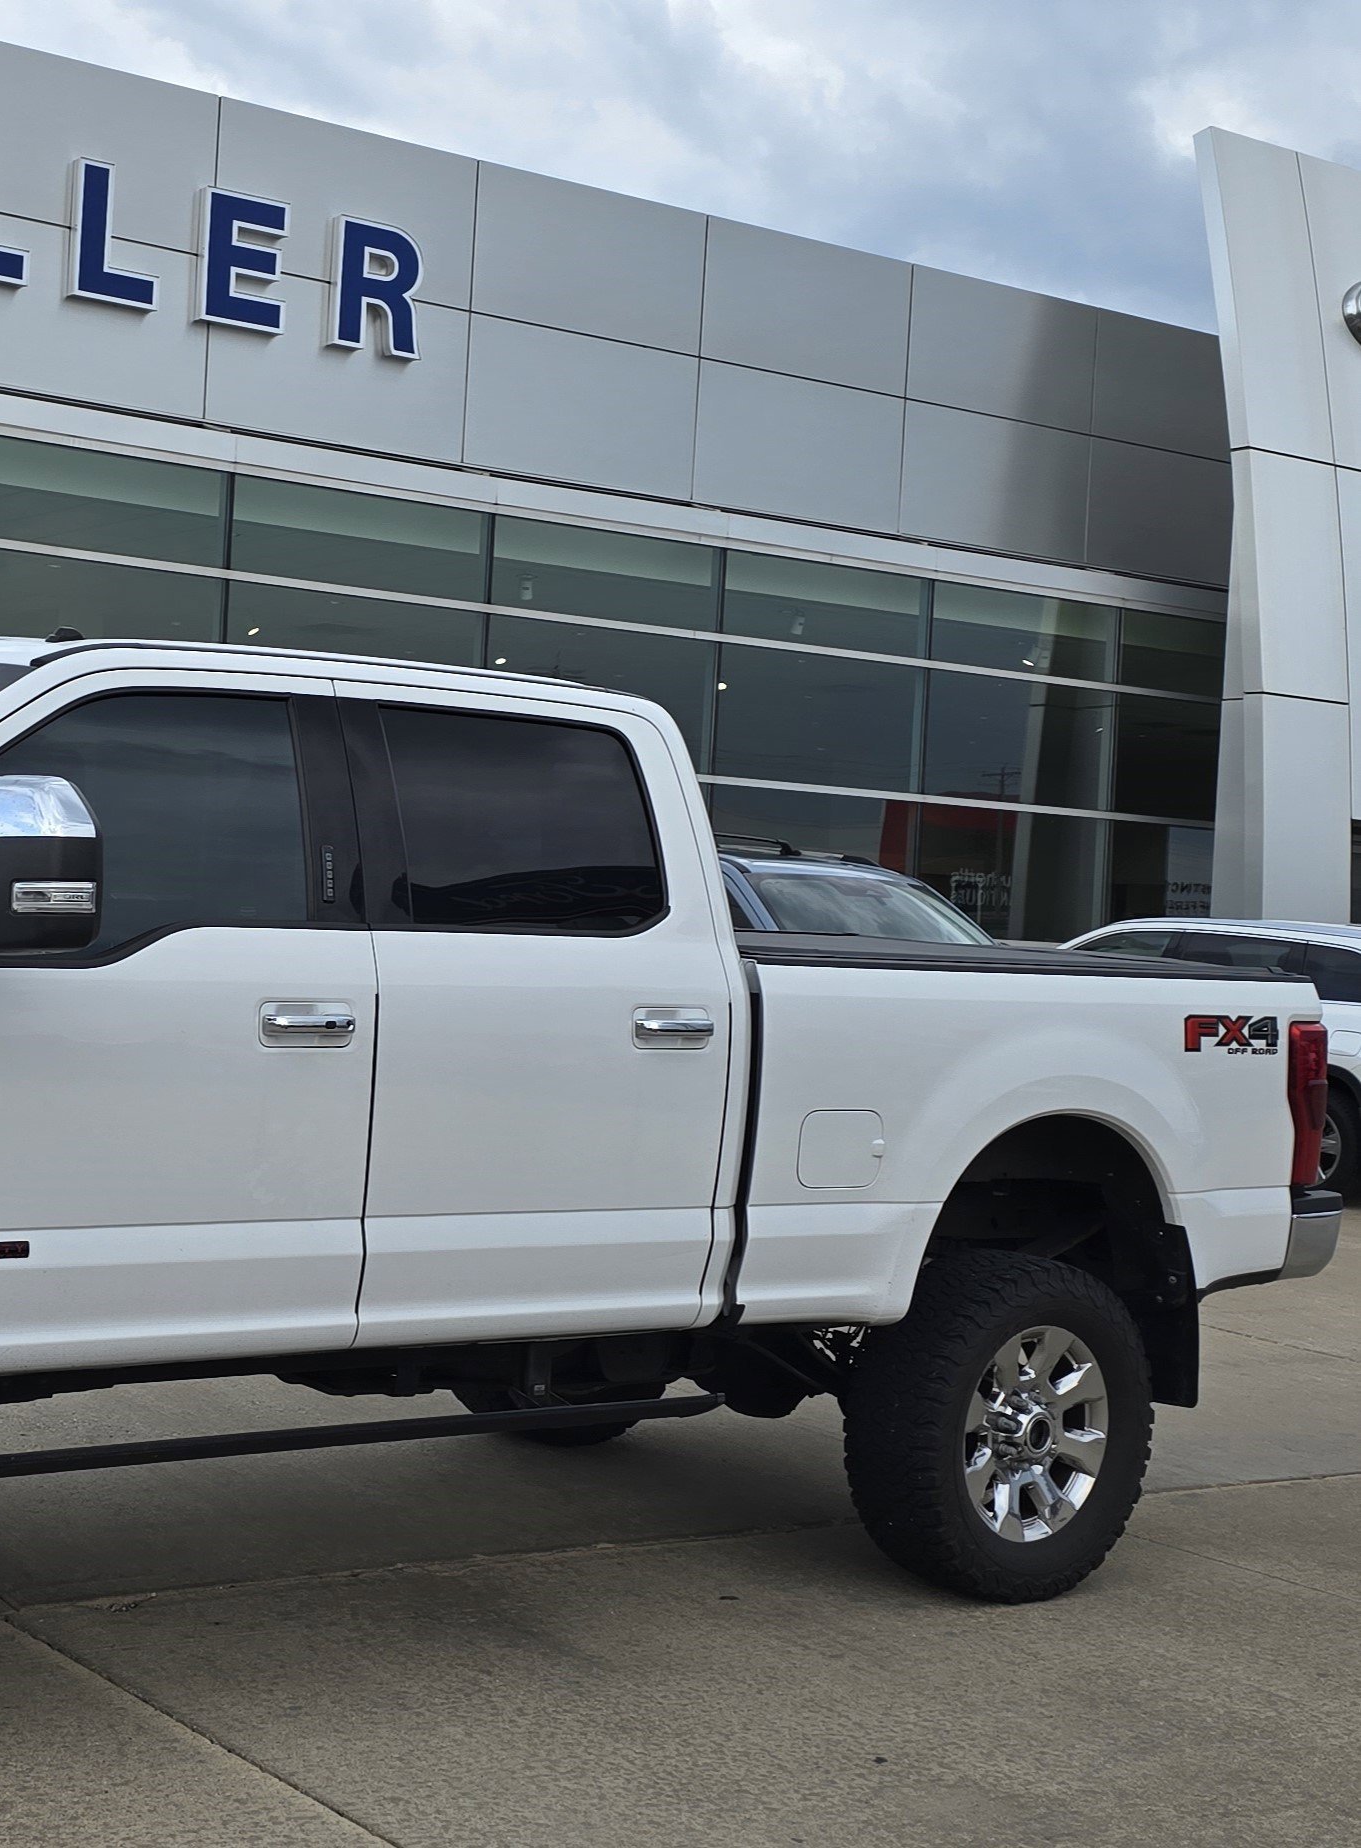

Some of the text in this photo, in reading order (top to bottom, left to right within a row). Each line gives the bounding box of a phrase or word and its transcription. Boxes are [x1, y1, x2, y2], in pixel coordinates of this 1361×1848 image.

[1184, 1014, 1279, 1052] FX4
[1227, 1047, 1278, 1055] OFF ROAD
